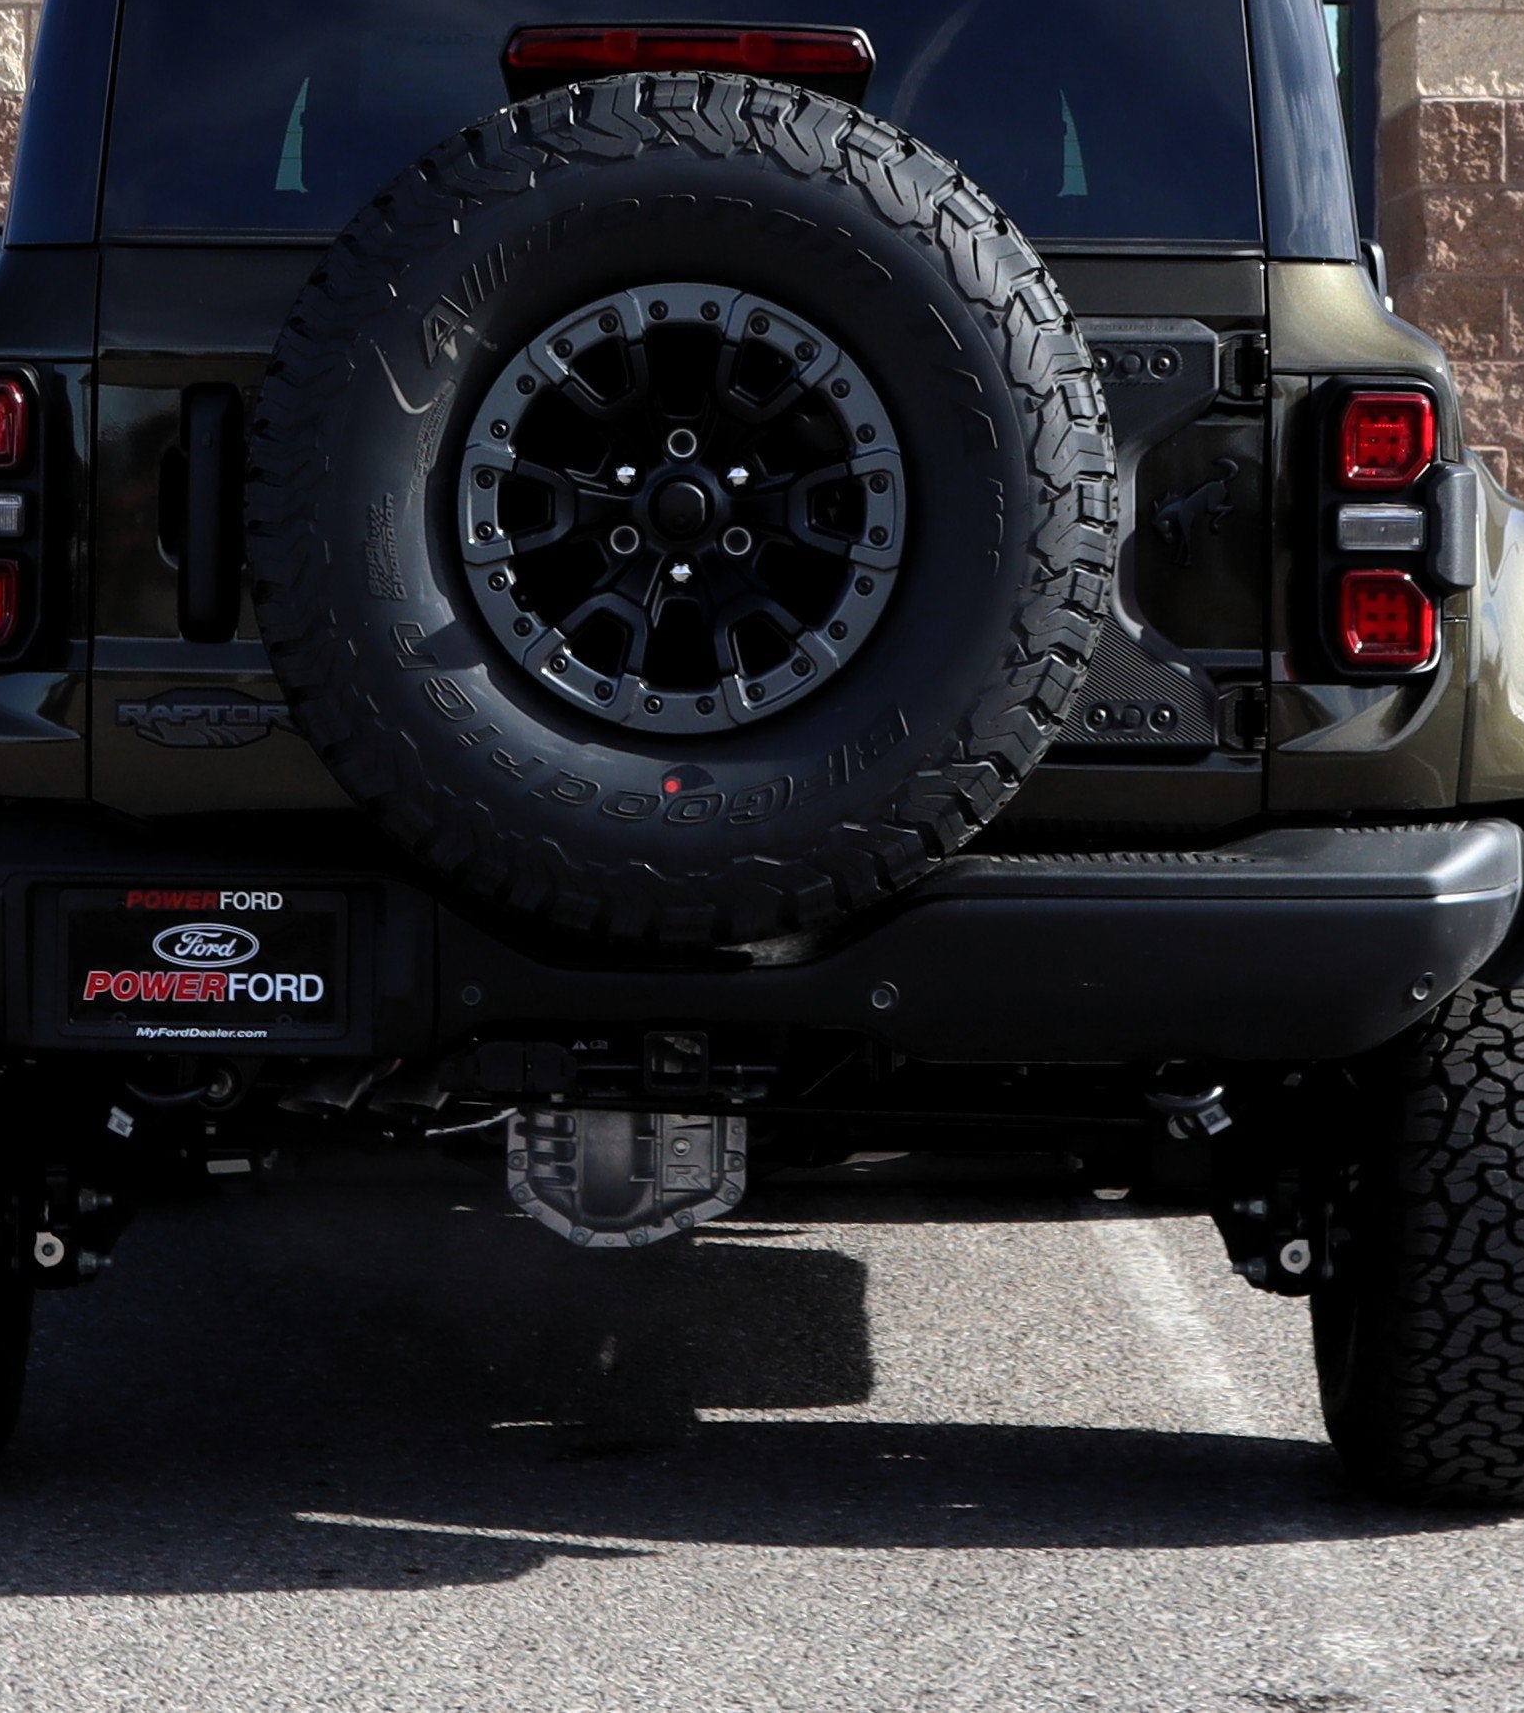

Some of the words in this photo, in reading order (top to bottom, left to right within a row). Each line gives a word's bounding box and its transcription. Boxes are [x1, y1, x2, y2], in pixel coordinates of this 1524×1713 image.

[117, 703, 297, 731] RAPTOR
[174, 930, 238, 957] Ford
[136, 1026, 268, 1039] MyFordDealer.com
